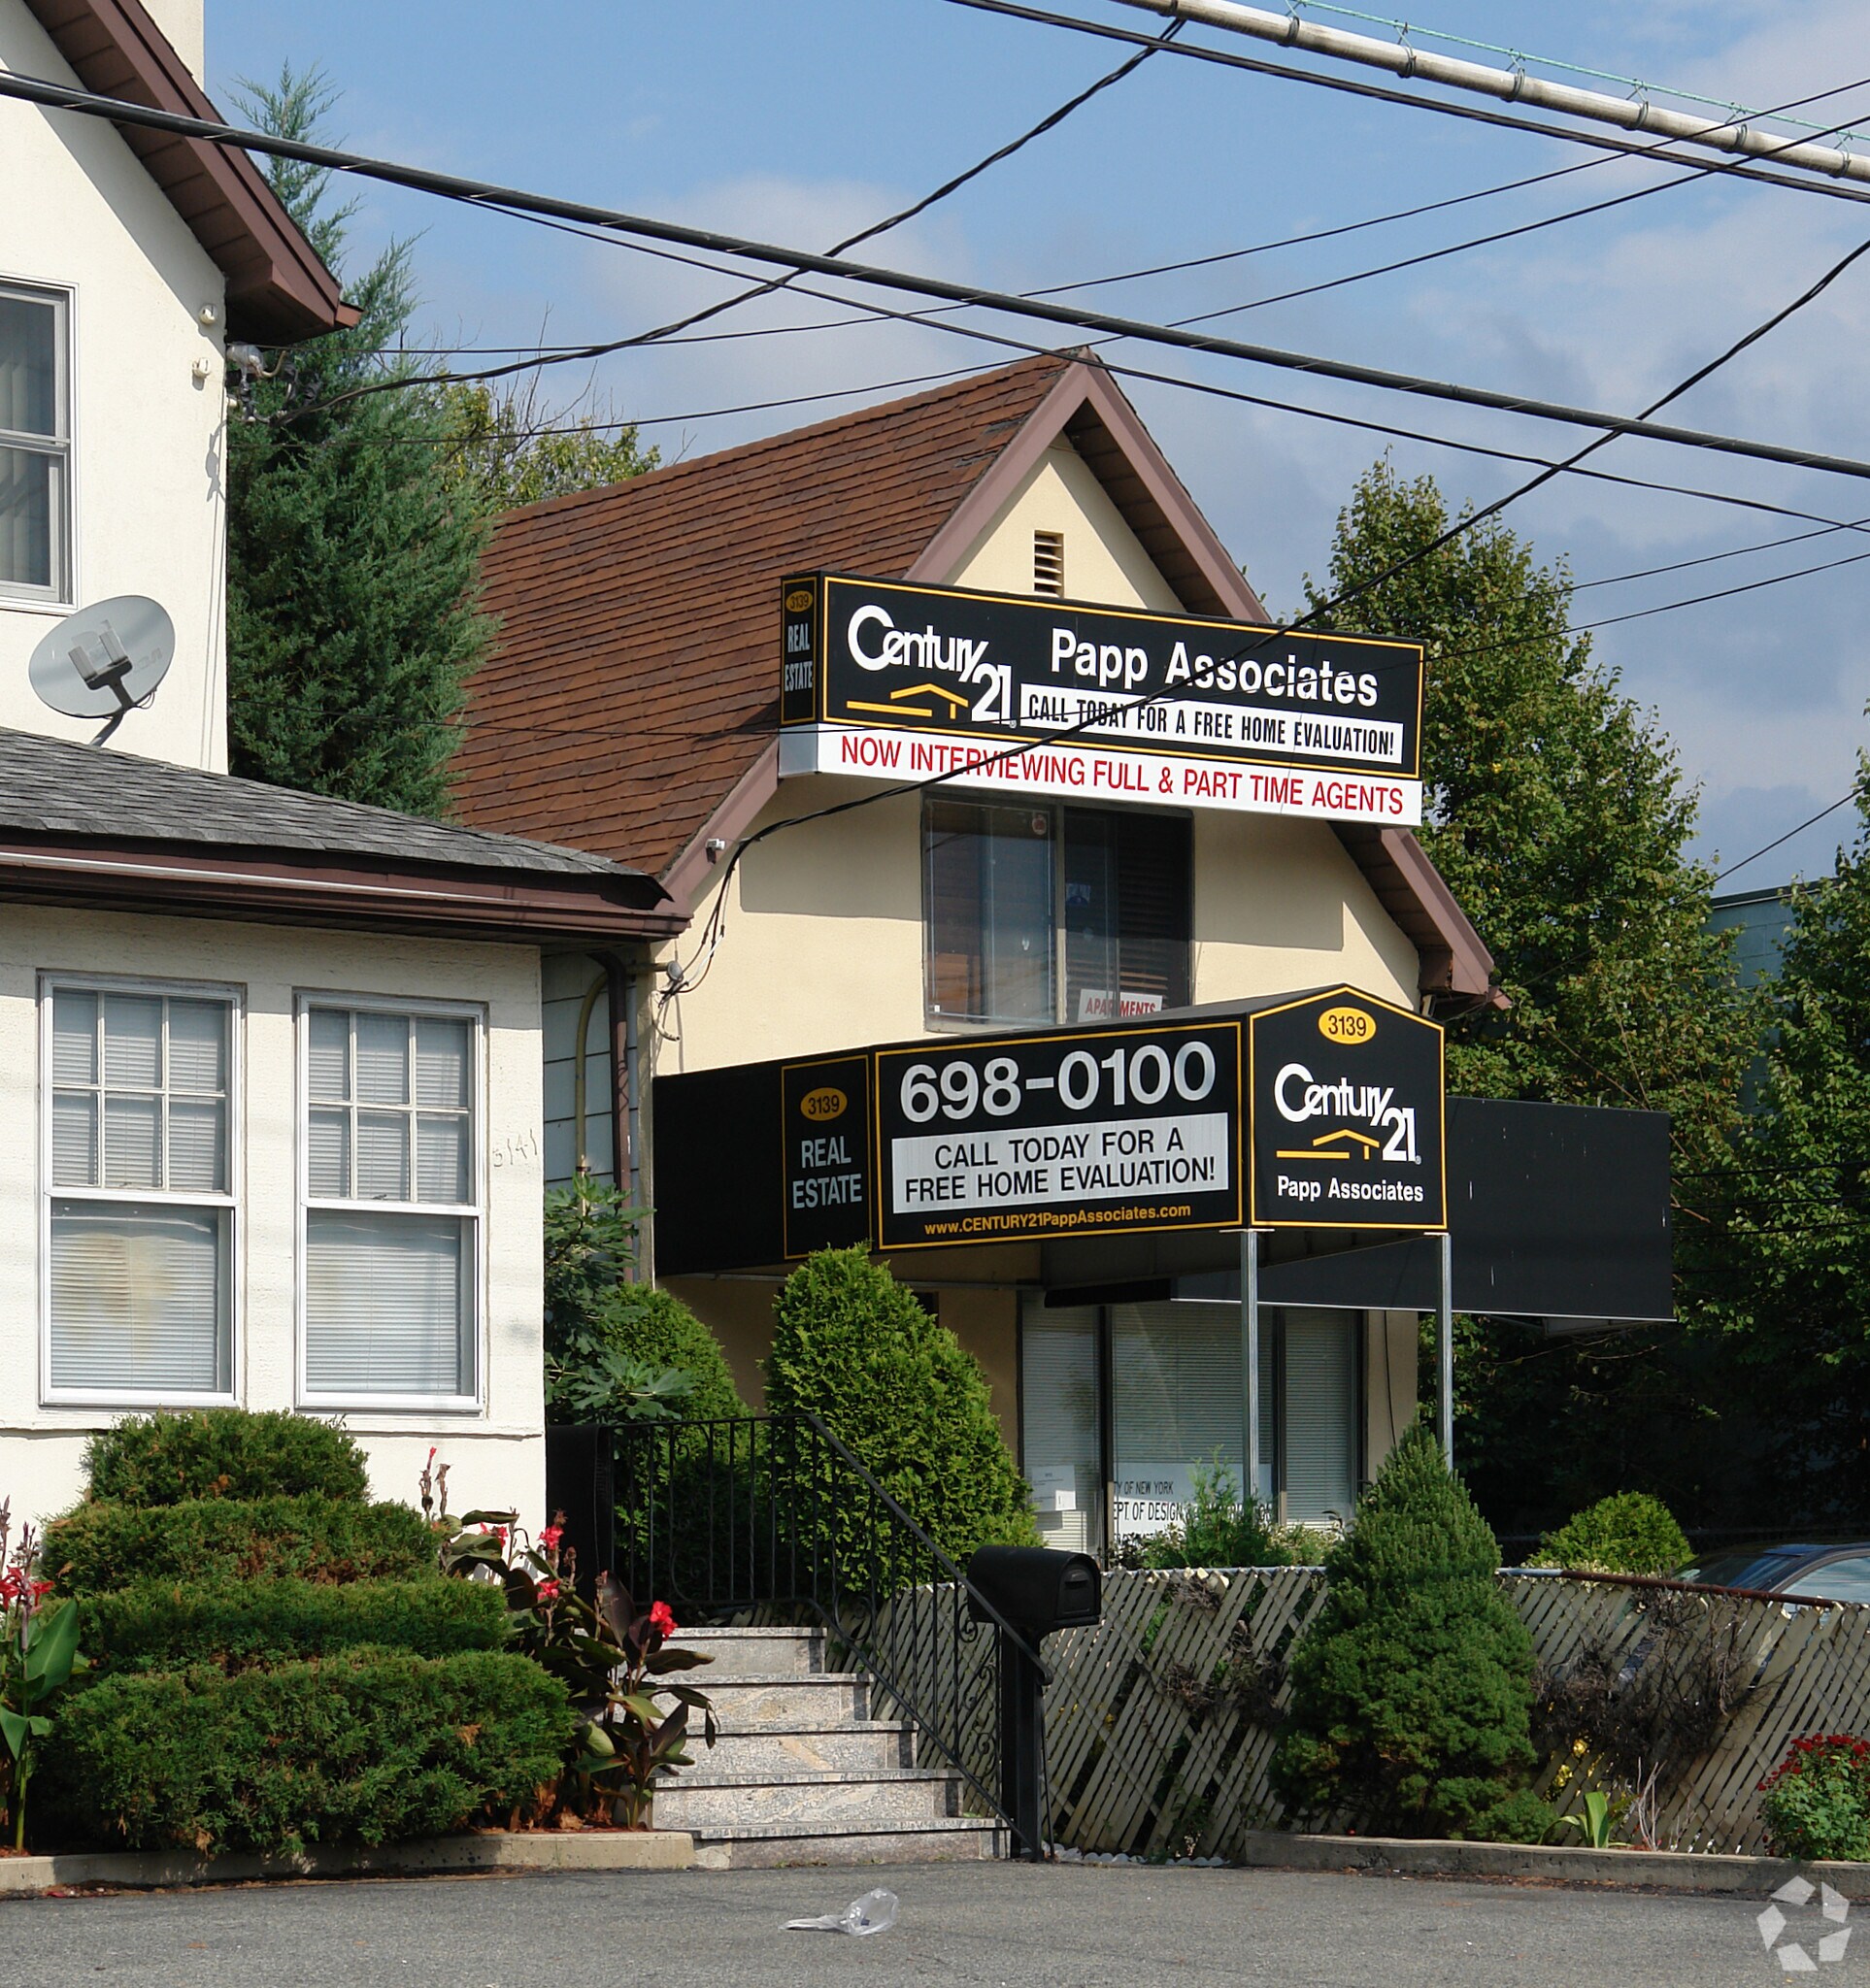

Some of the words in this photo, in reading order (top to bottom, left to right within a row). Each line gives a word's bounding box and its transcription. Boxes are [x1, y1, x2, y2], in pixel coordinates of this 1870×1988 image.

[789, 593, 810, 610] 3139
[787, 622, 811, 653] REAL
[847, 604, 989, 682] Century
[785, 660, 814, 692] ESTATE
[1051, 626, 1149, 690] Papp
[1165, 641, 1378, 708] Associates
[971, 662, 1012, 725] 21
[1028, 693, 1069, 723] CALL
[1077, 698, 1128, 729] TODAY
[1137, 703, 1167, 733] FOR
[1175, 709, 1185, 734] A
[1194, 711, 1233, 740] FREE
[1241, 715, 1286, 745] HOME
[1294, 721, 1395, 756] EVALUATION!
[841, 735, 902, 768] NOW
[910, 742, 1085, 786] INTERVIEWING
[1093, 760, 1150, 793] FULL
[1158, 766, 1174, 794] &
[1184, 771, 1248, 801] PART
[1250, 775, 1304, 806] TIME
[1311, 781, 1404, 816] AGENTS
[1085, 996, 1156, 1017] APARMENTS
[1328, 1014, 1367, 1037] 3139
[899, 1040, 1217, 1124] 698-0100
[1274, 1062, 1395, 1127] Century
[807, 1094, 841, 1116] 3139
[801, 1135, 852, 1169] REAL
[934, 1141, 998, 1170] CALL
[1009, 1134, 1090, 1163] TODAY
[1101, 1128, 1155, 1157] FOR
[1166, 1126, 1185, 1152] A
[1381, 1107, 1418, 1163] 21
[792, 1173, 863, 1209] ESTATE
[905, 1176, 966, 1204] FREE
[977, 1169, 1050, 1197] HOME
[1060, 1155, 1216, 1192] EVALUATION!
[1277, 1175, 1321, 1203] Papp
[1328, 1176, 1424, 1203] Associates
[923, 1203, 1192, 1236] www.CENTURY21PappAssociates.com
[1123, 1480, 1135, 1495] OF
[1135, 1480, 1152, 1495] NEW
[1153, 1480, 1174, 1495] YORK
[1131, 1501, 1146, 1521] OF
[1147, 1501, 1185, 1521] DESIGN
